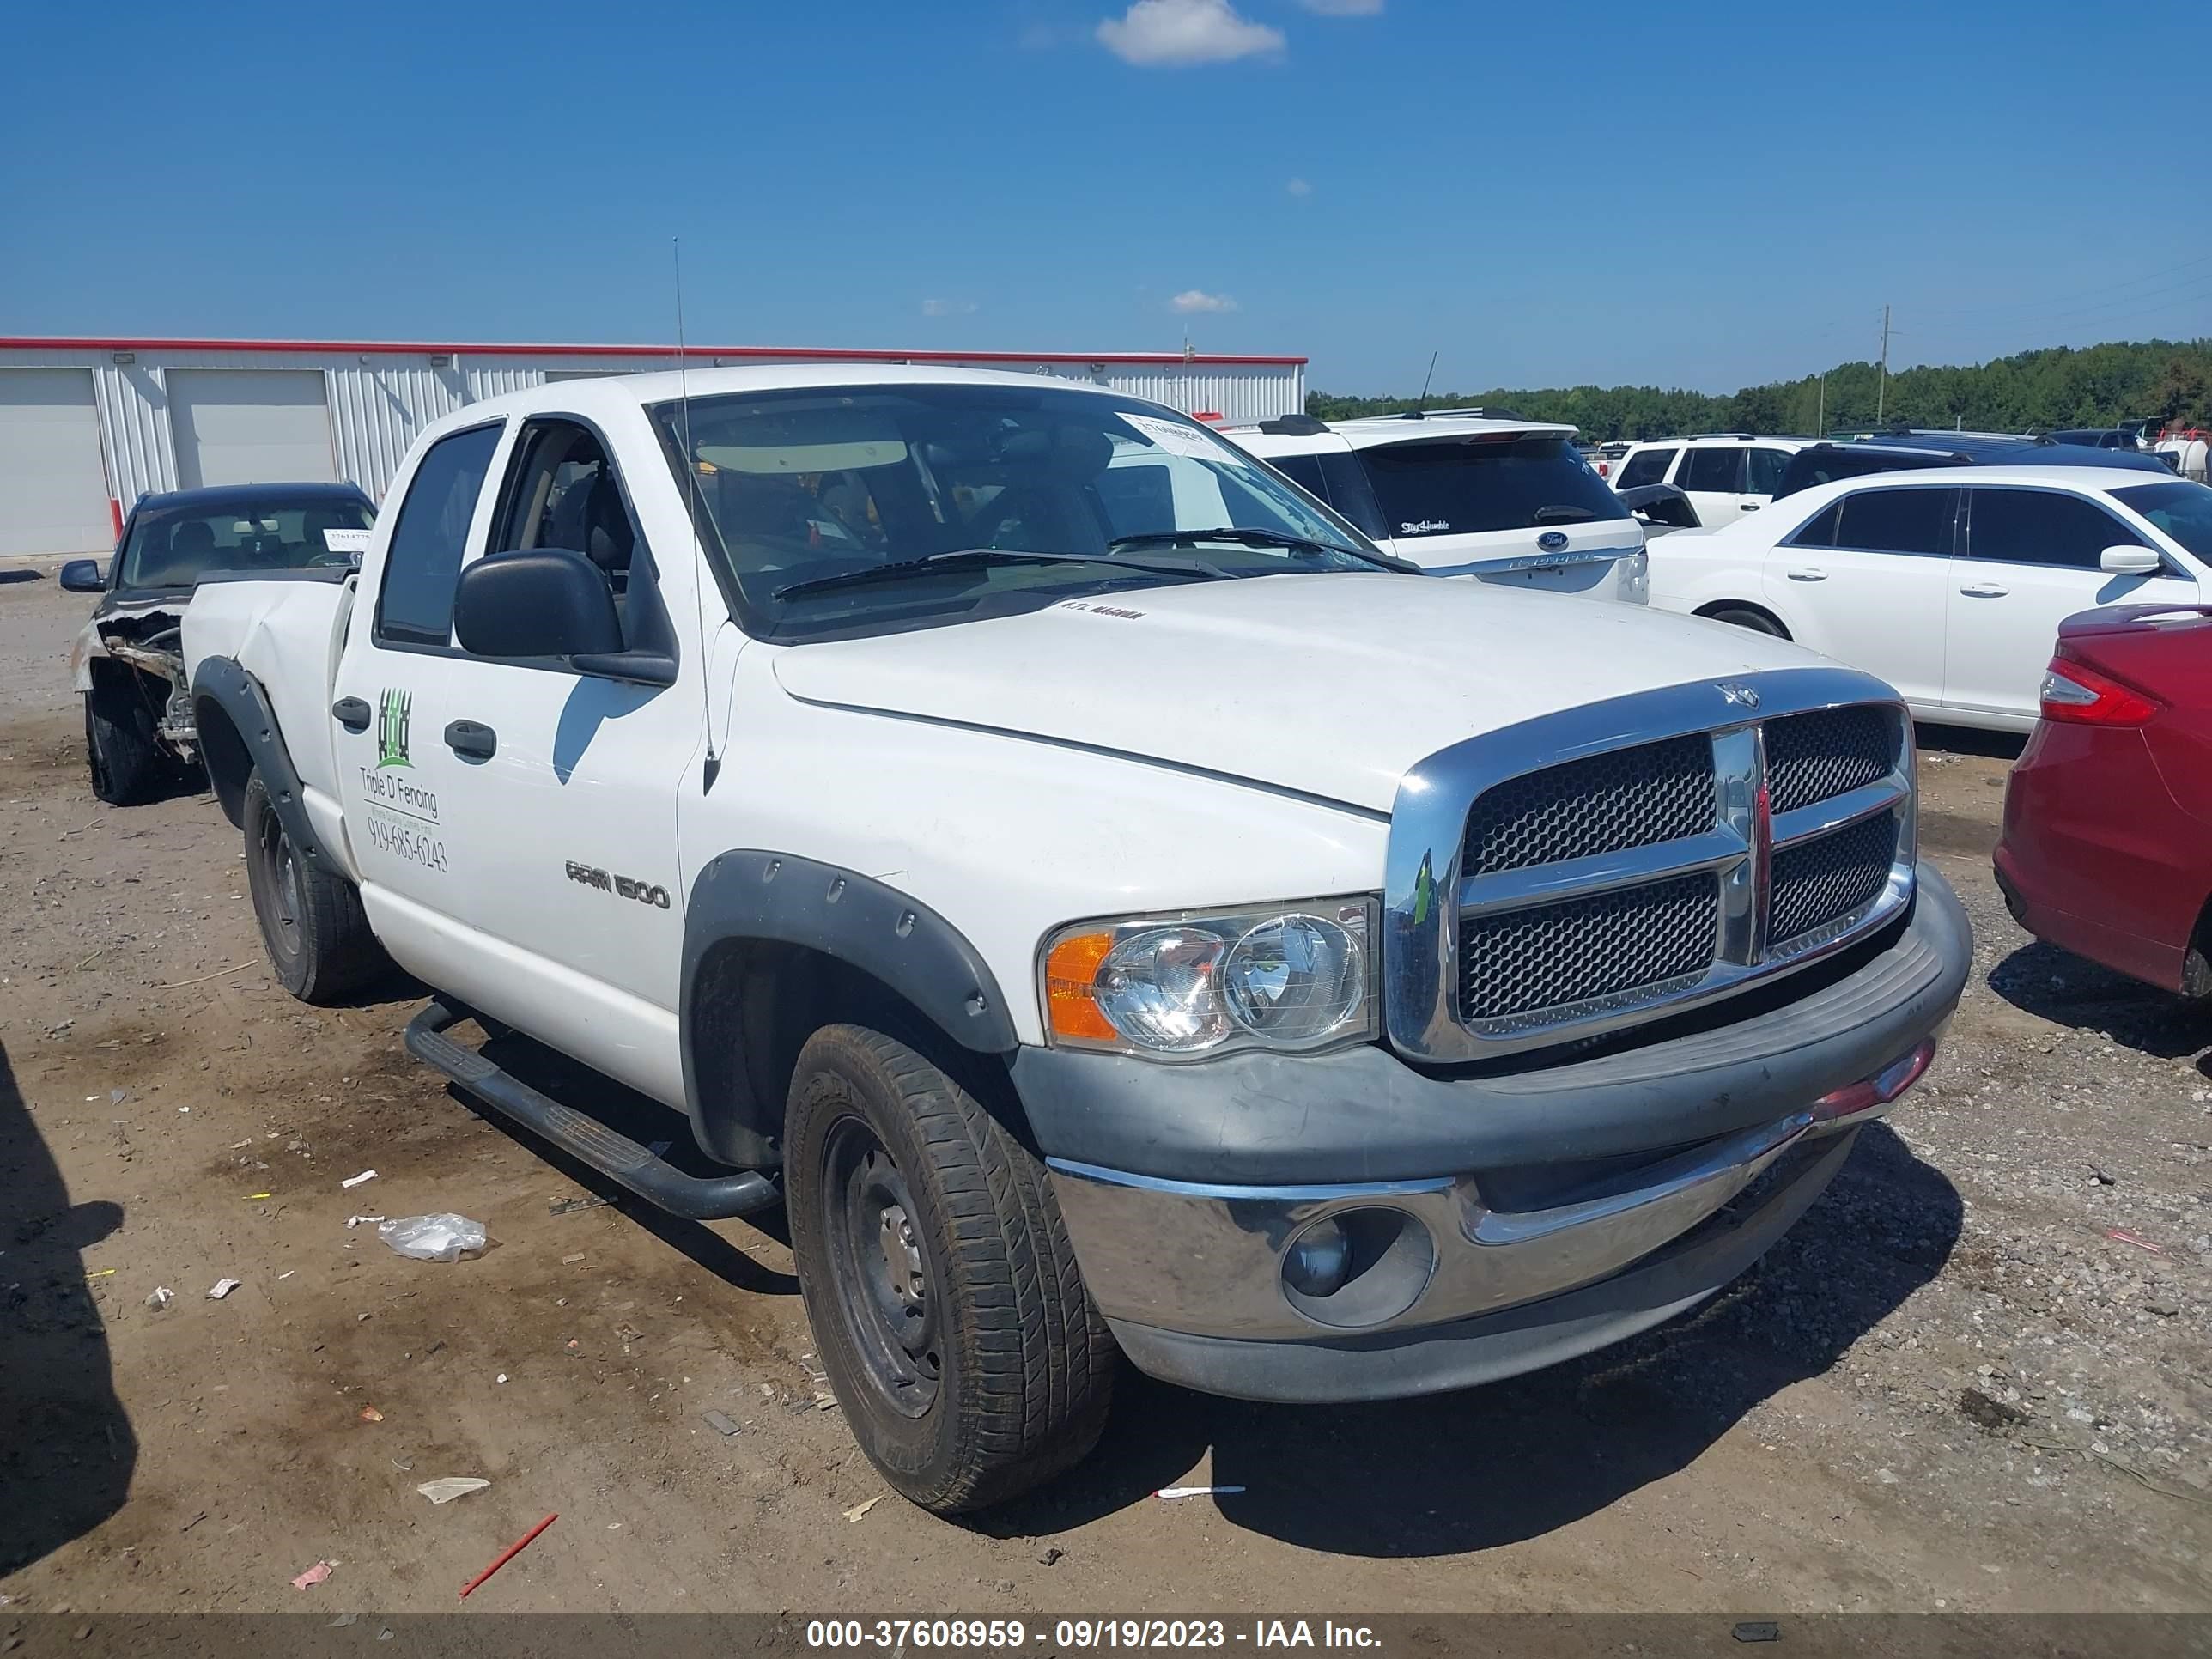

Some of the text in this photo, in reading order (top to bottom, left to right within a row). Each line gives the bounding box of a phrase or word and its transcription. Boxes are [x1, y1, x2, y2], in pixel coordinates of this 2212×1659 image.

[1545, 532, 1564, 544] Ford
[360, 766, 439, 819] Triple D Fencing
[368, 817, 448, 873] 919-685-6243
[565, 860, 671, 909] RAM 1500
